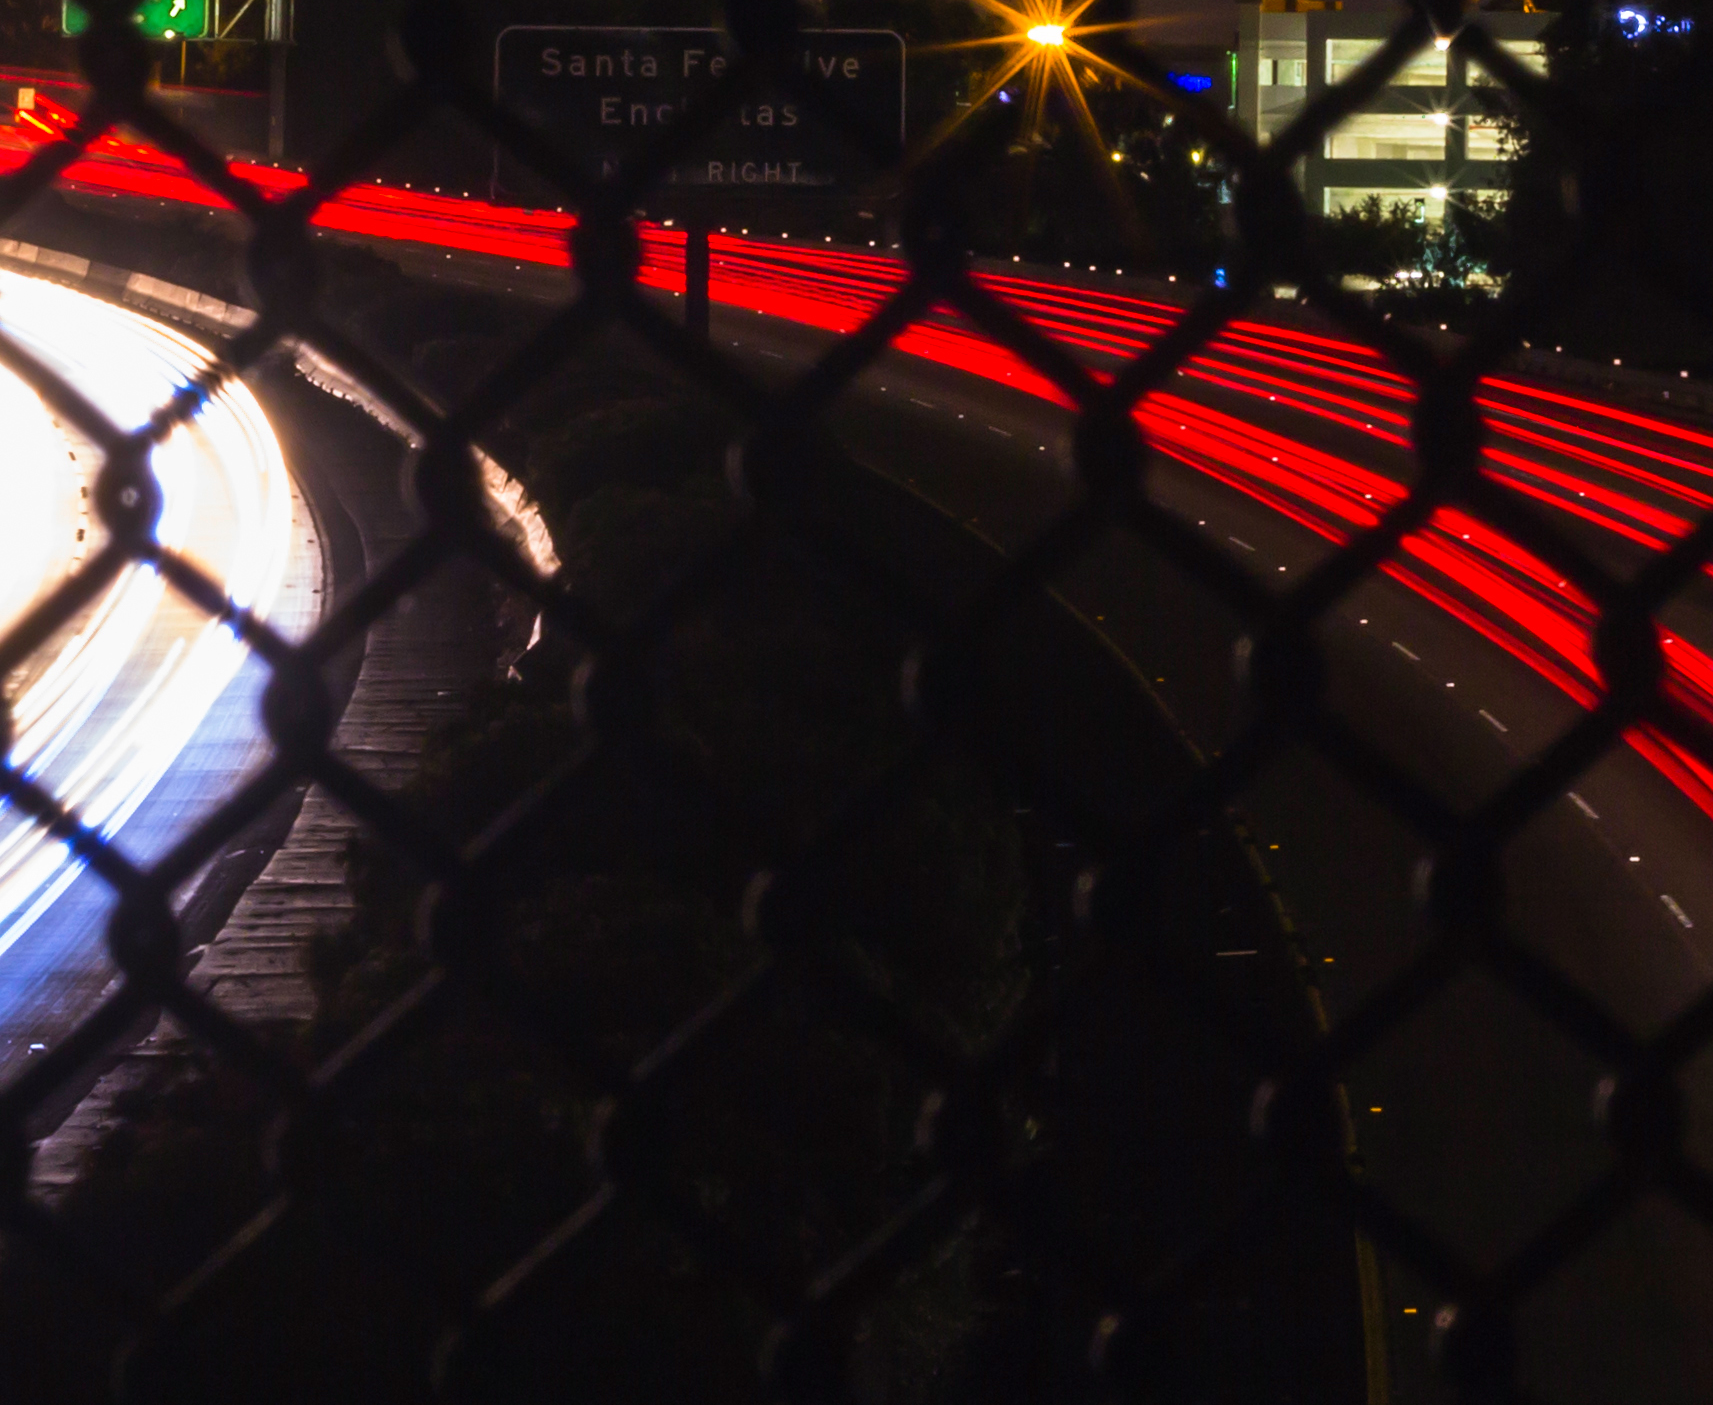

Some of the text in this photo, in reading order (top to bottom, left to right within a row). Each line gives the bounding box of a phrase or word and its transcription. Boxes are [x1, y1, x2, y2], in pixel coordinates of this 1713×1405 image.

[541, 48, 658, 78] Santa
[683, 50, 728, 78] Fe
[600, 97, 799, 127] Enctas
[707, 161, 803, 184] RIGHT
